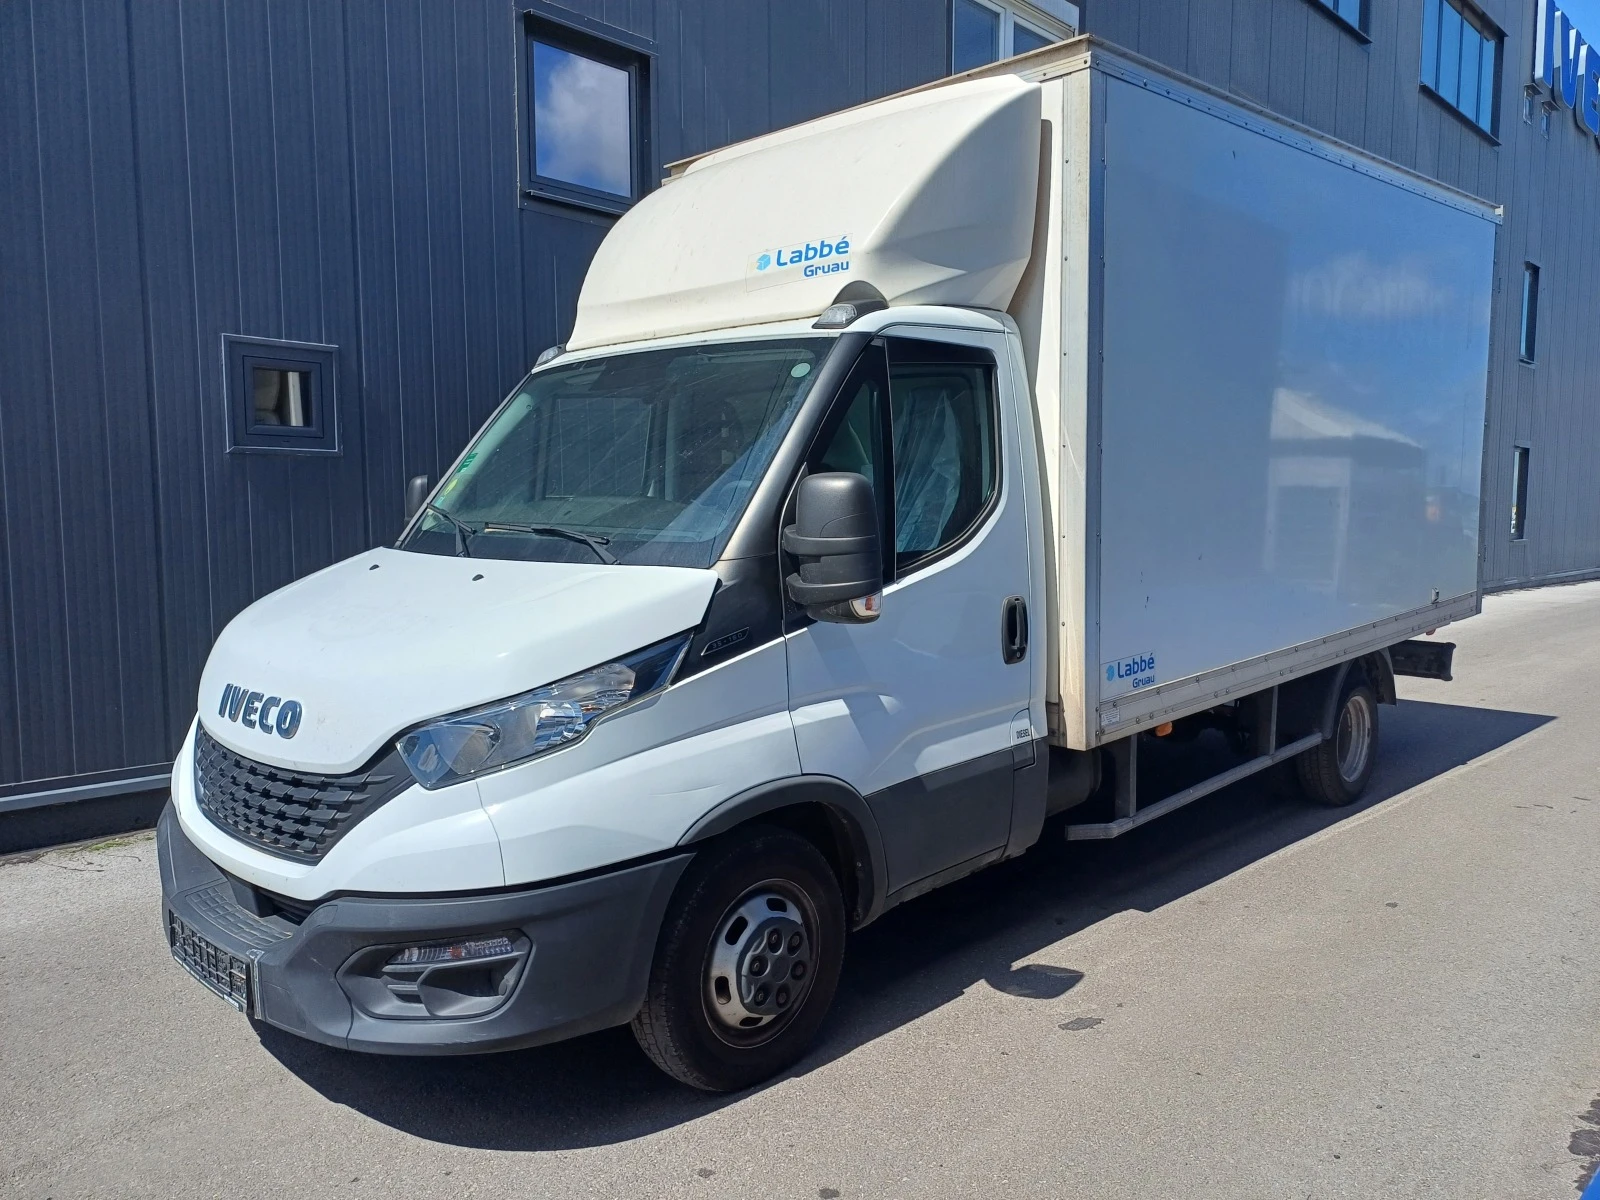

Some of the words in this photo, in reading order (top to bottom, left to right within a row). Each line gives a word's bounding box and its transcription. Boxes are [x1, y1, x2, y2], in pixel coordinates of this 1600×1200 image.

[776, 236, 849, 266] Labbé
[804, 261, 849, 277] Gruau
[1117, 652, 1155, 679] Labbé
[1132, 674, 1155, 688] Gruau
[218, 683, 303, 740] IVECO
[1015, 728, 1031, 740] DIESEL
